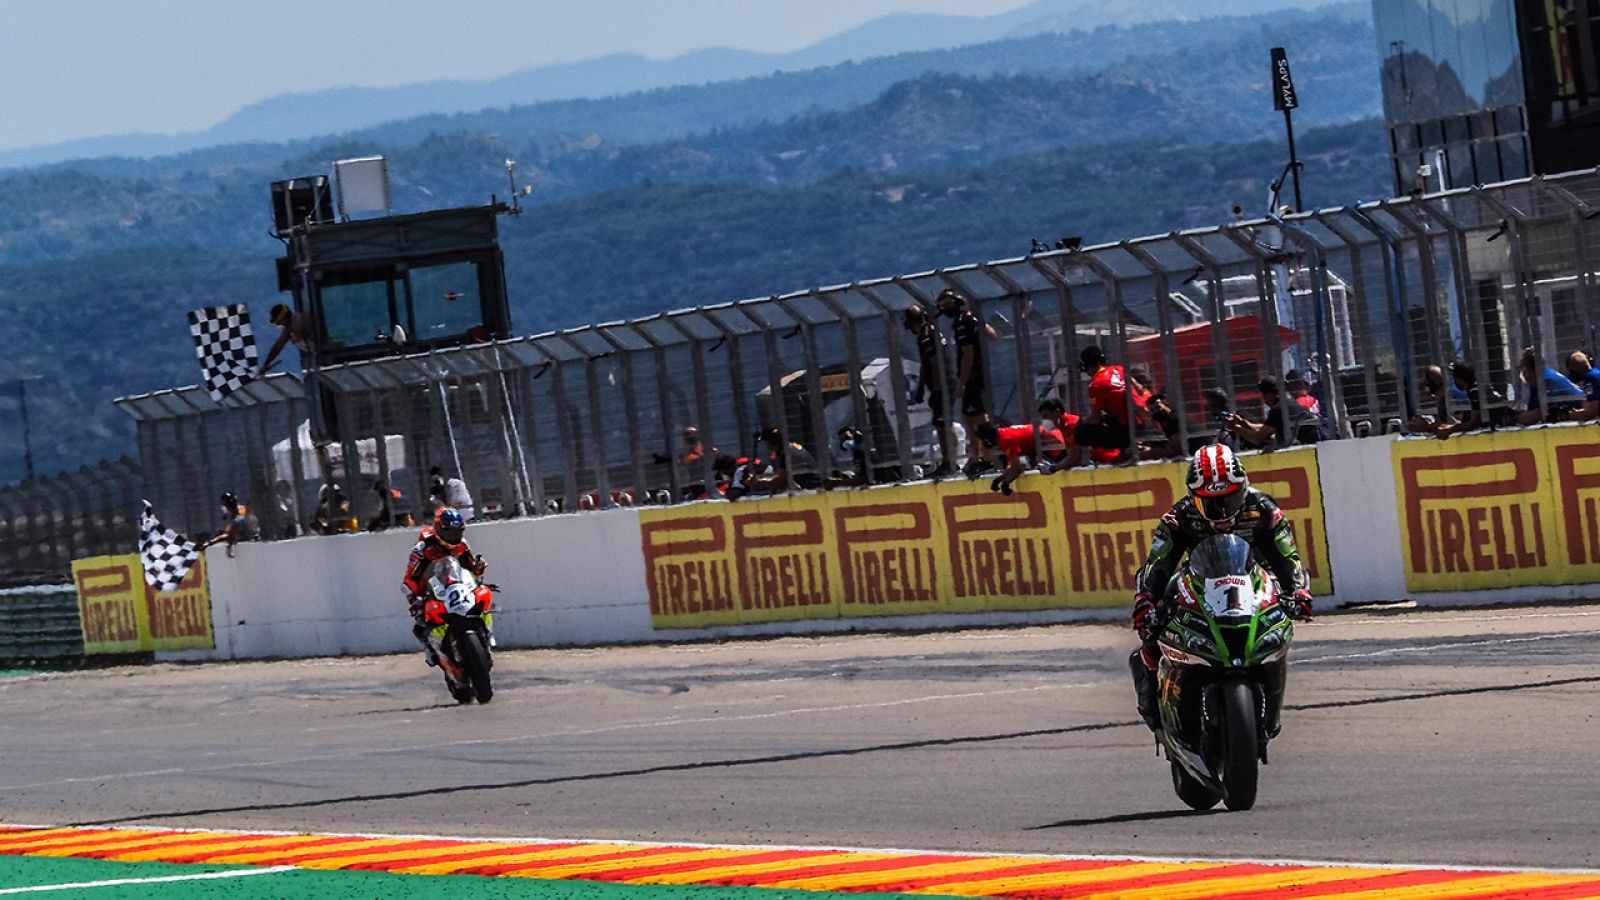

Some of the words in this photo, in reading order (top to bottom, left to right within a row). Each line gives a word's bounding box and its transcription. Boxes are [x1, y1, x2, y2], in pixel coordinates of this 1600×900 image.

[1278, 59, 1294, 107] MYLAPS
[733, 509, 831, 610] PIRELLI
[834, 502, 939, 604] PIRELLI
[942, 491, 1056, 597] PIRELLI
[1061, 478, 1174, 592] PIRE
[1401, 448, 1548, 574] PIRELLI
[78, 564, 138, 643] PIRELLI
[641, 515, 734, 615] PIRELLI
[1221, 586, 1244, 614] 1
